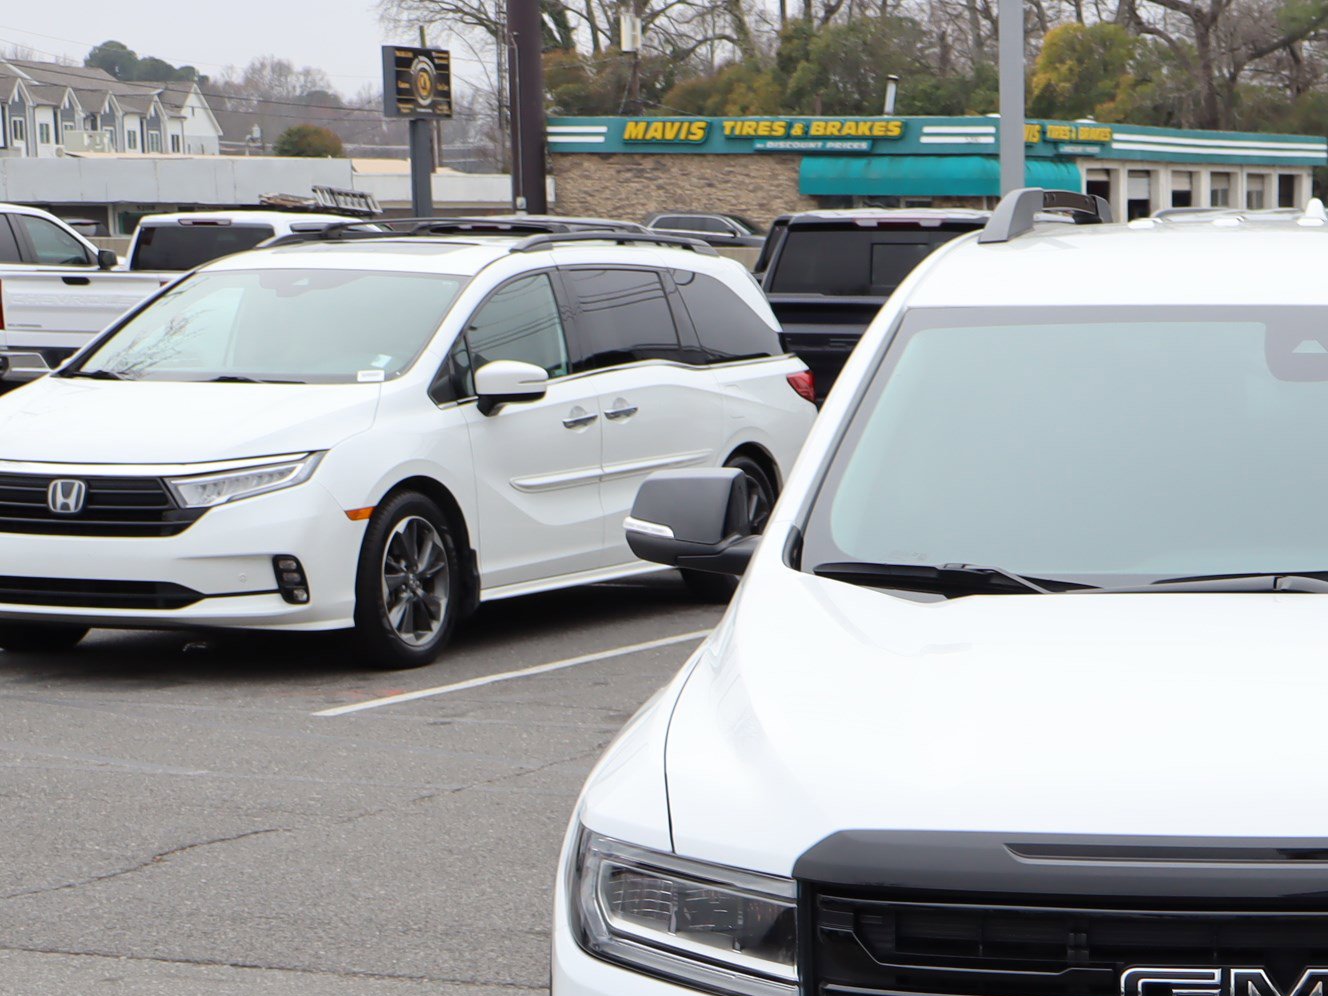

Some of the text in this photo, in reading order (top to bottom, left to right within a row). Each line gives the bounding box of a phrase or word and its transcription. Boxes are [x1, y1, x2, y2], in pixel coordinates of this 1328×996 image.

[623, 121, 902, 140] MAVIS TIRES & BRAKES
[766, 141, 823, 149] DISCOUNT
